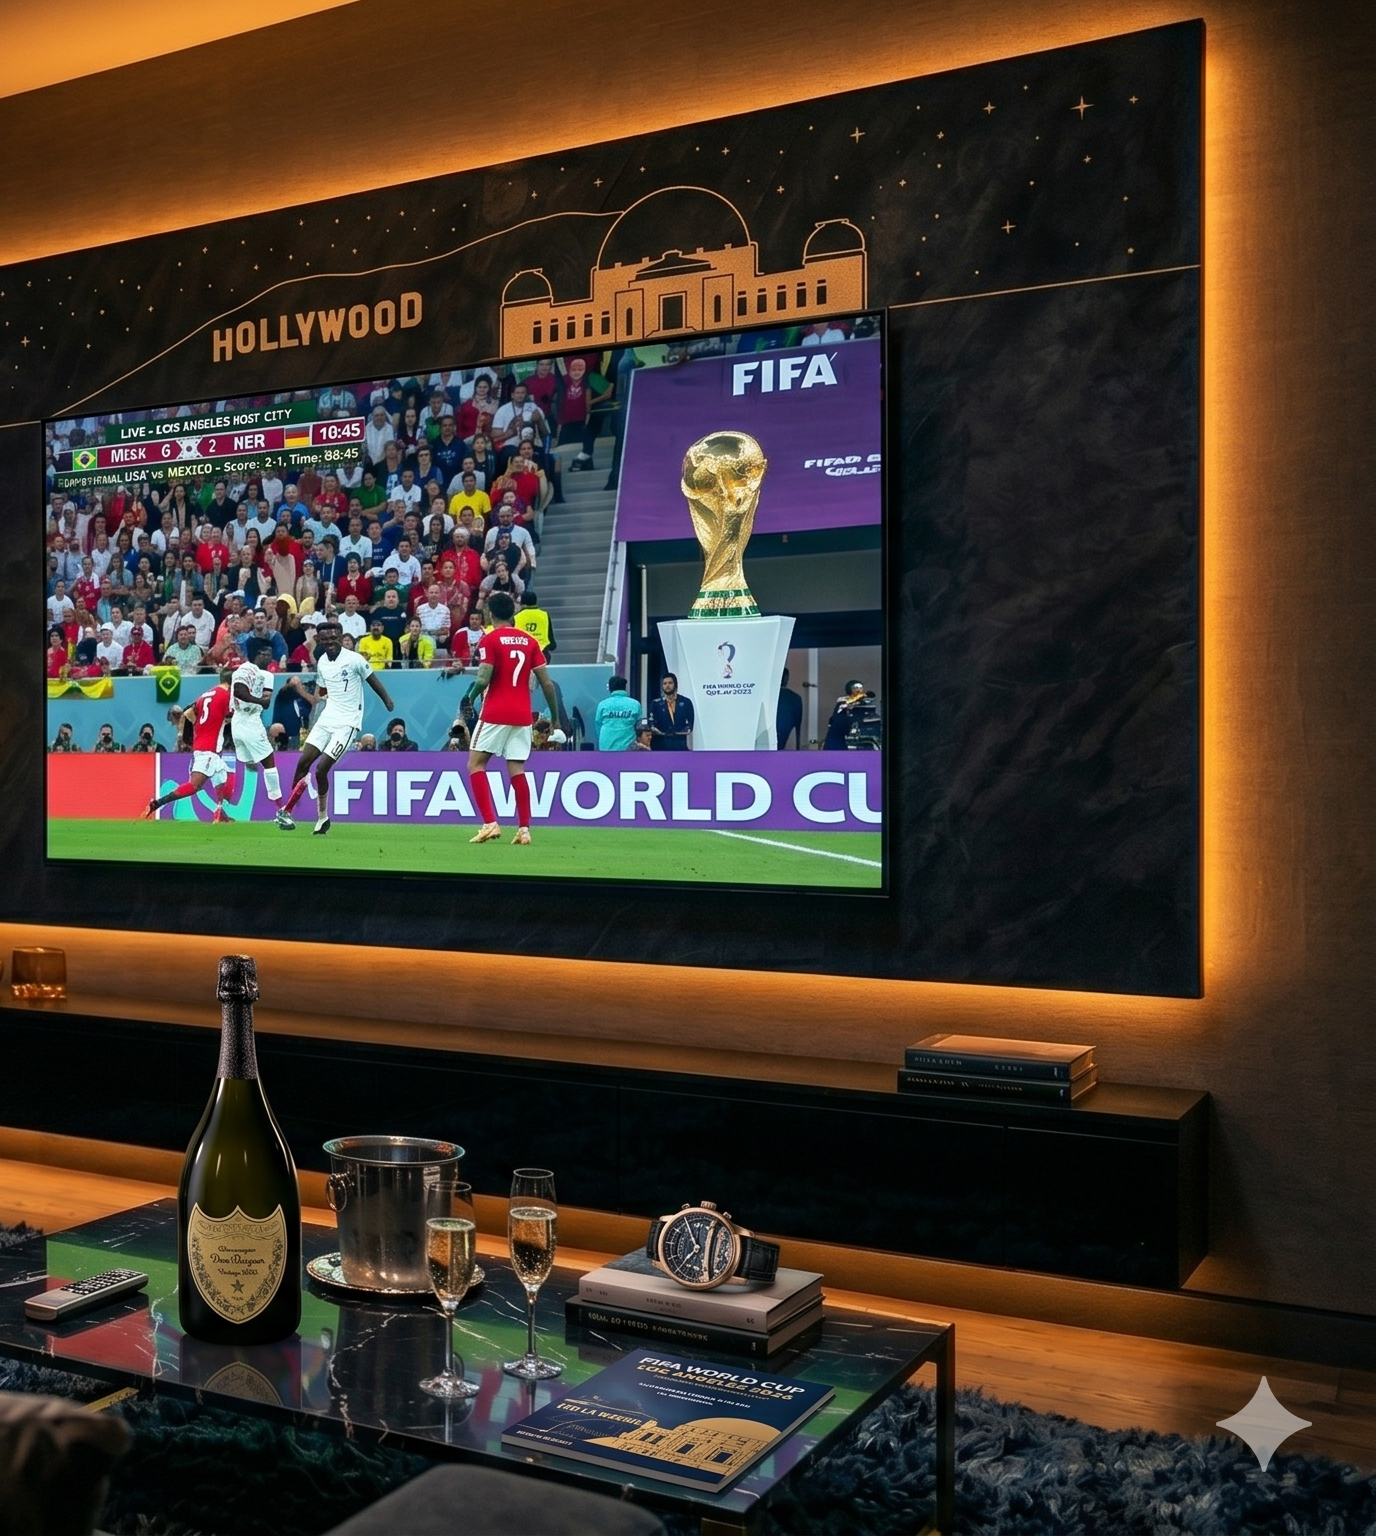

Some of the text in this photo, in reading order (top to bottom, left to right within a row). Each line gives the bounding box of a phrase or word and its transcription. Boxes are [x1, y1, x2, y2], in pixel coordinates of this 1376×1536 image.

[212, 291, 423, 363] HOLLYWOOD
[732, 352, 838, 396] FIFA
[120, 426, 146, 439] LIVE
[233, 413, 261, 426] HOST
[264, 409, 293, 422] CITY
[208, 439, 216, 453] 2
[233, 434, 266, 451] NER
[151, 470, 164, 479] vs
[167, 463, 213, 478] MEXICO
[223, 461, 260, 472] Score:
[264, 456, 287, 468] 2-1,
[289, 453, 322, 465] Time:
[509, 650, 526, 687] 7
[342, 678, 349, 692] 7
[333, 770, 477, 817] FIFA
[487, 770, 773, 822] WORLD
[760, 1381, 806, 1395] CUP
